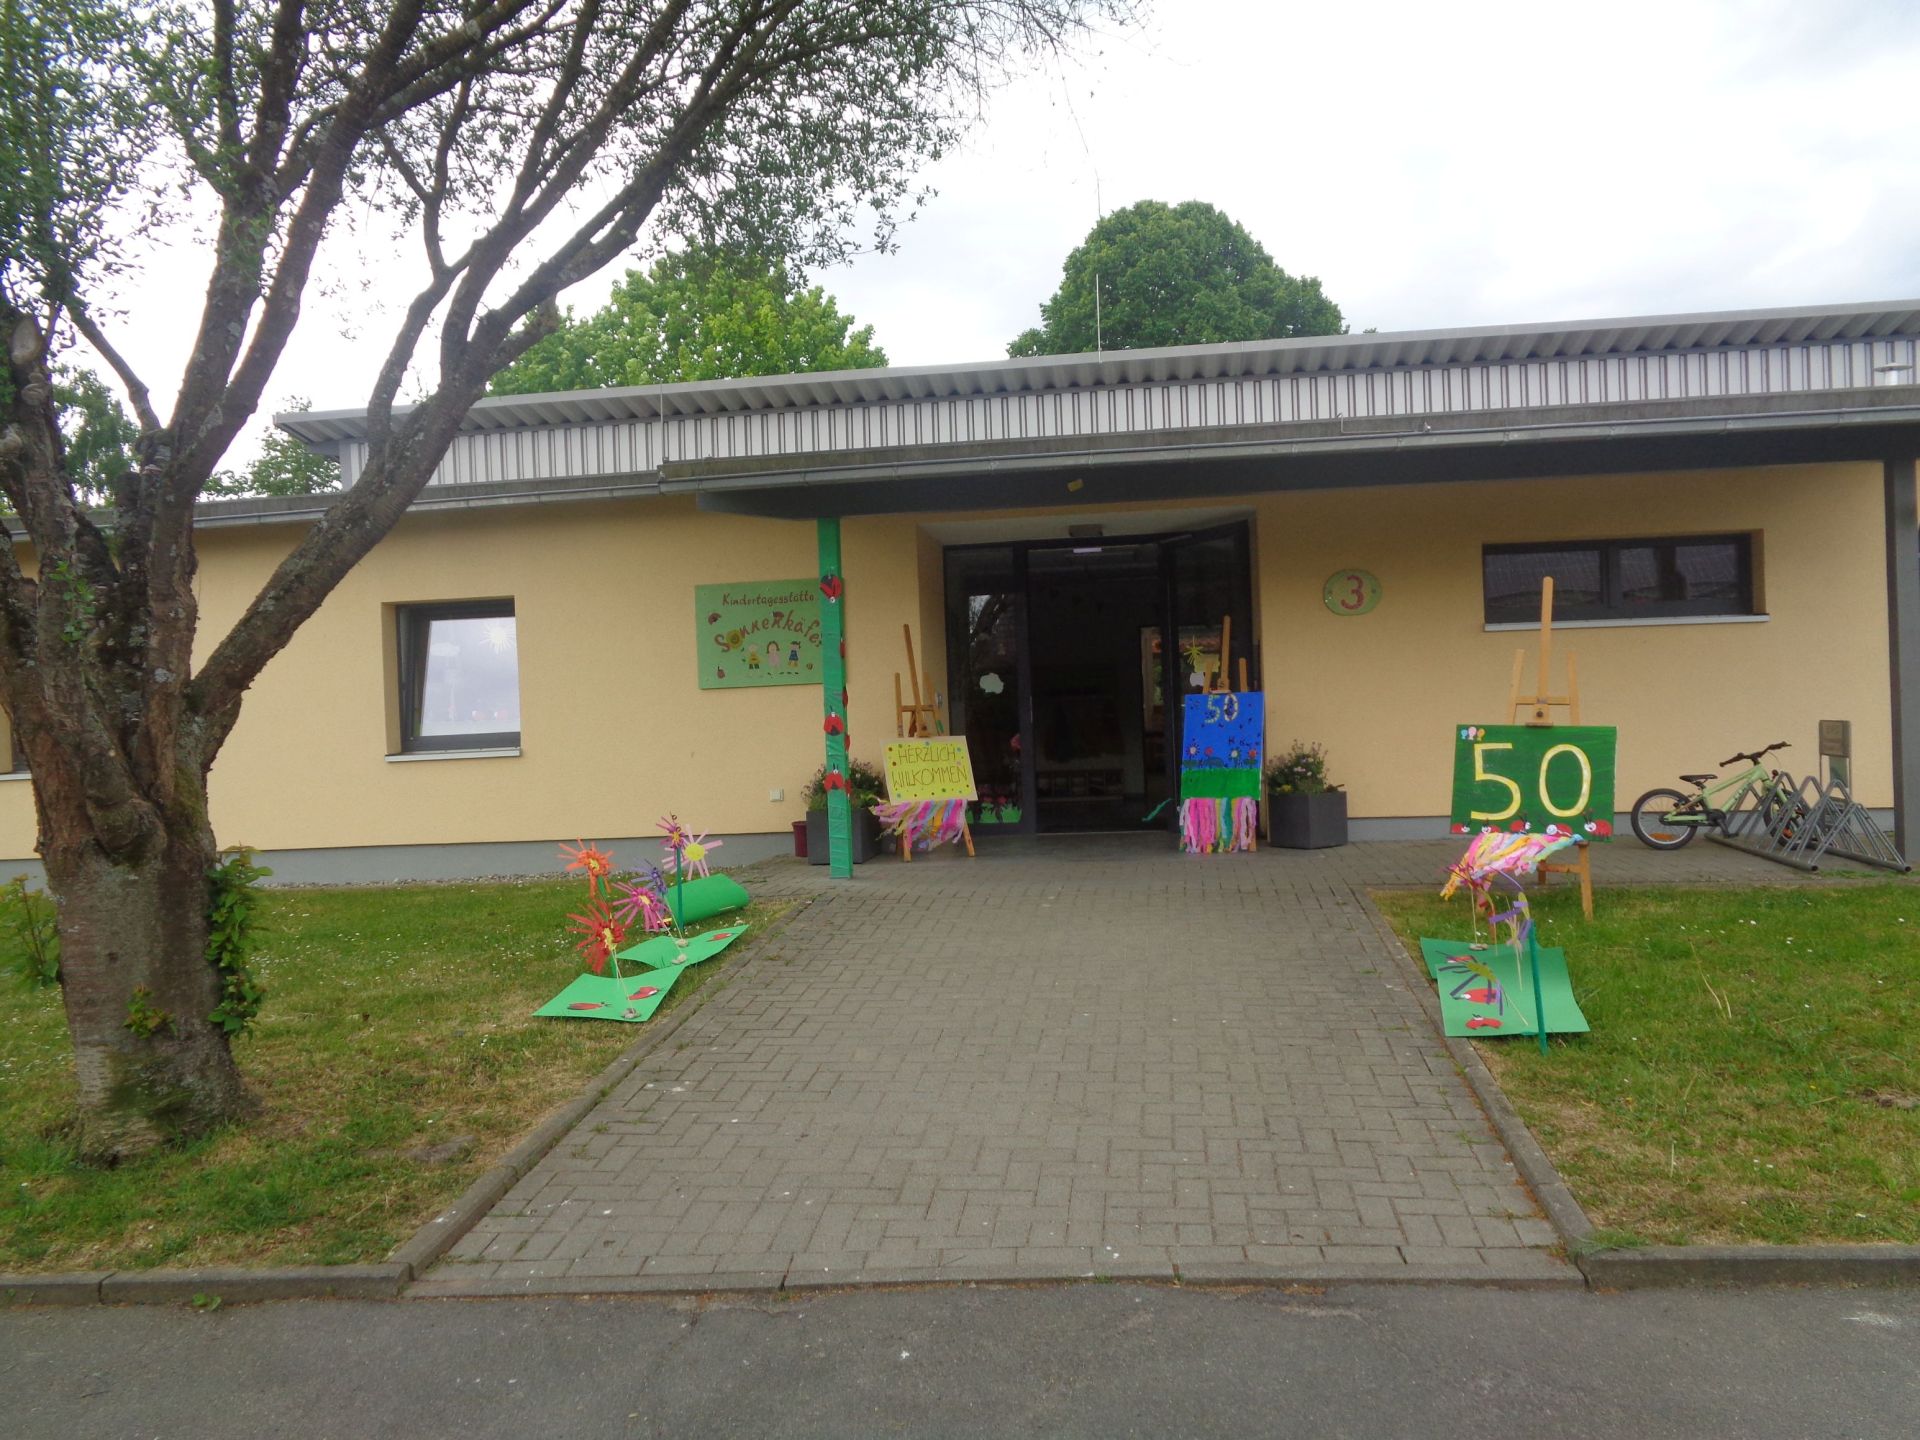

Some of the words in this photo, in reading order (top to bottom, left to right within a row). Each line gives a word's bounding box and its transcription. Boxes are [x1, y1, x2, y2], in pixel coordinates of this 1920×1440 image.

[1341, 575, 1364, 610] 3
[713, 609, 821, 653] Sonnenkäfe
[1204, 693, 1239, 724] 50
[898, 745, 956, 765] HERZLICH
[1470, 742, 1592, 821] 50
